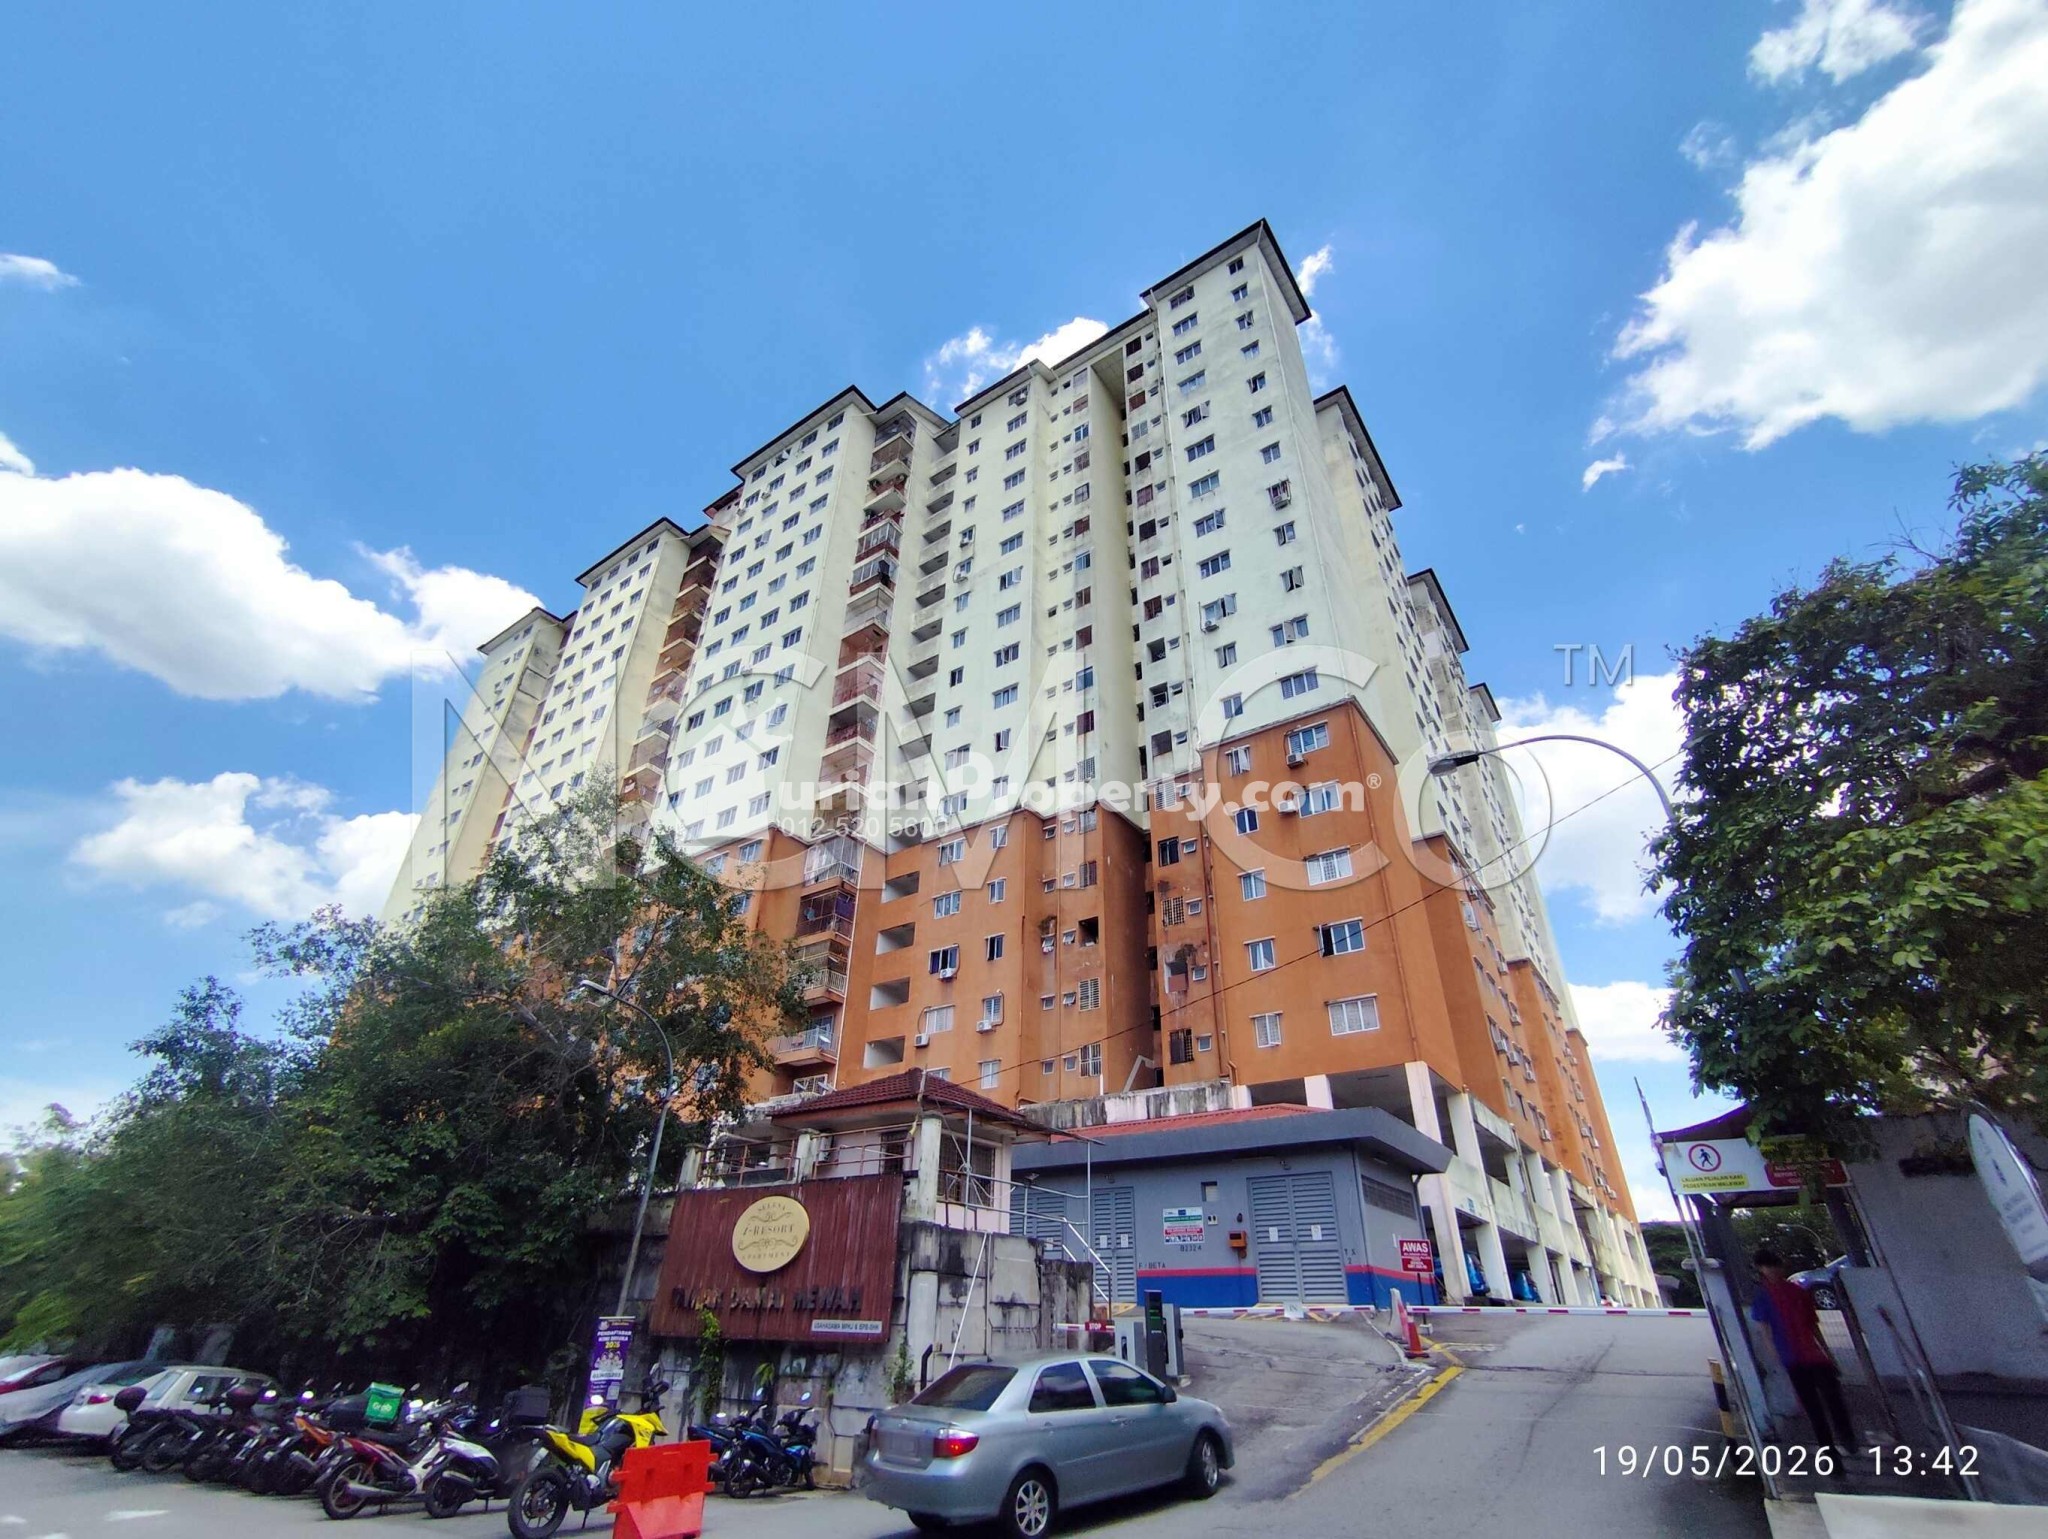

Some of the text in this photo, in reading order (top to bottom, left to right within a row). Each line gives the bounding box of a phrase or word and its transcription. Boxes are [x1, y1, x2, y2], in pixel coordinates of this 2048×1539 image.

[1402, 1242, 1429, 1253] AWAS
[1089, 1322, 1102, 1330] STOP
[372, 1401, 393, 1412] Grab
